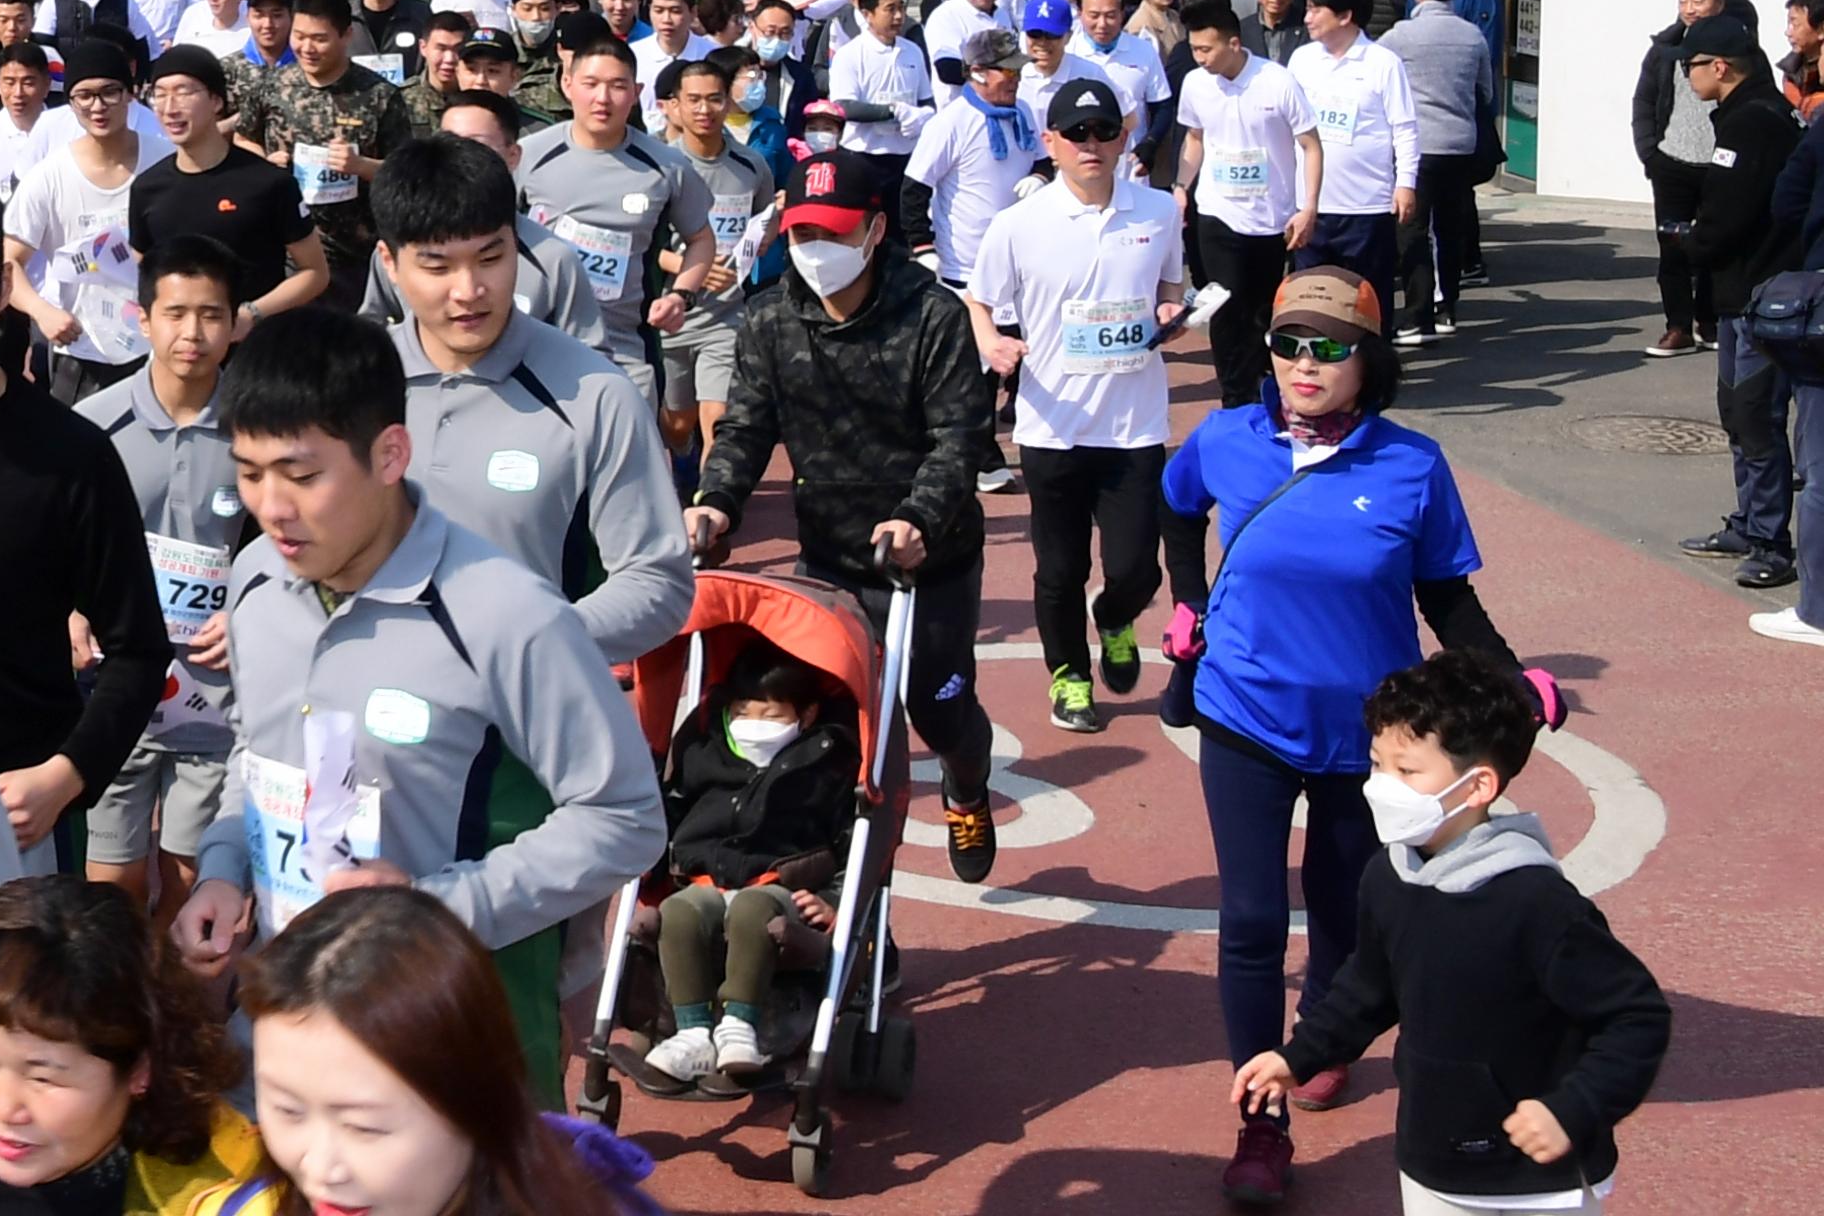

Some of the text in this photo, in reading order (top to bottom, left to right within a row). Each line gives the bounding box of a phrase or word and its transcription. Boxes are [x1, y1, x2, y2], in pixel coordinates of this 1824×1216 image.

[1319, 110, 1348, 126] 182
[1229, 166, 1261, 180] 522
[714, 216, 747, 233] 723
[1098, 324, 1144, 348] 648
[168, 578, 228, 611] 729
